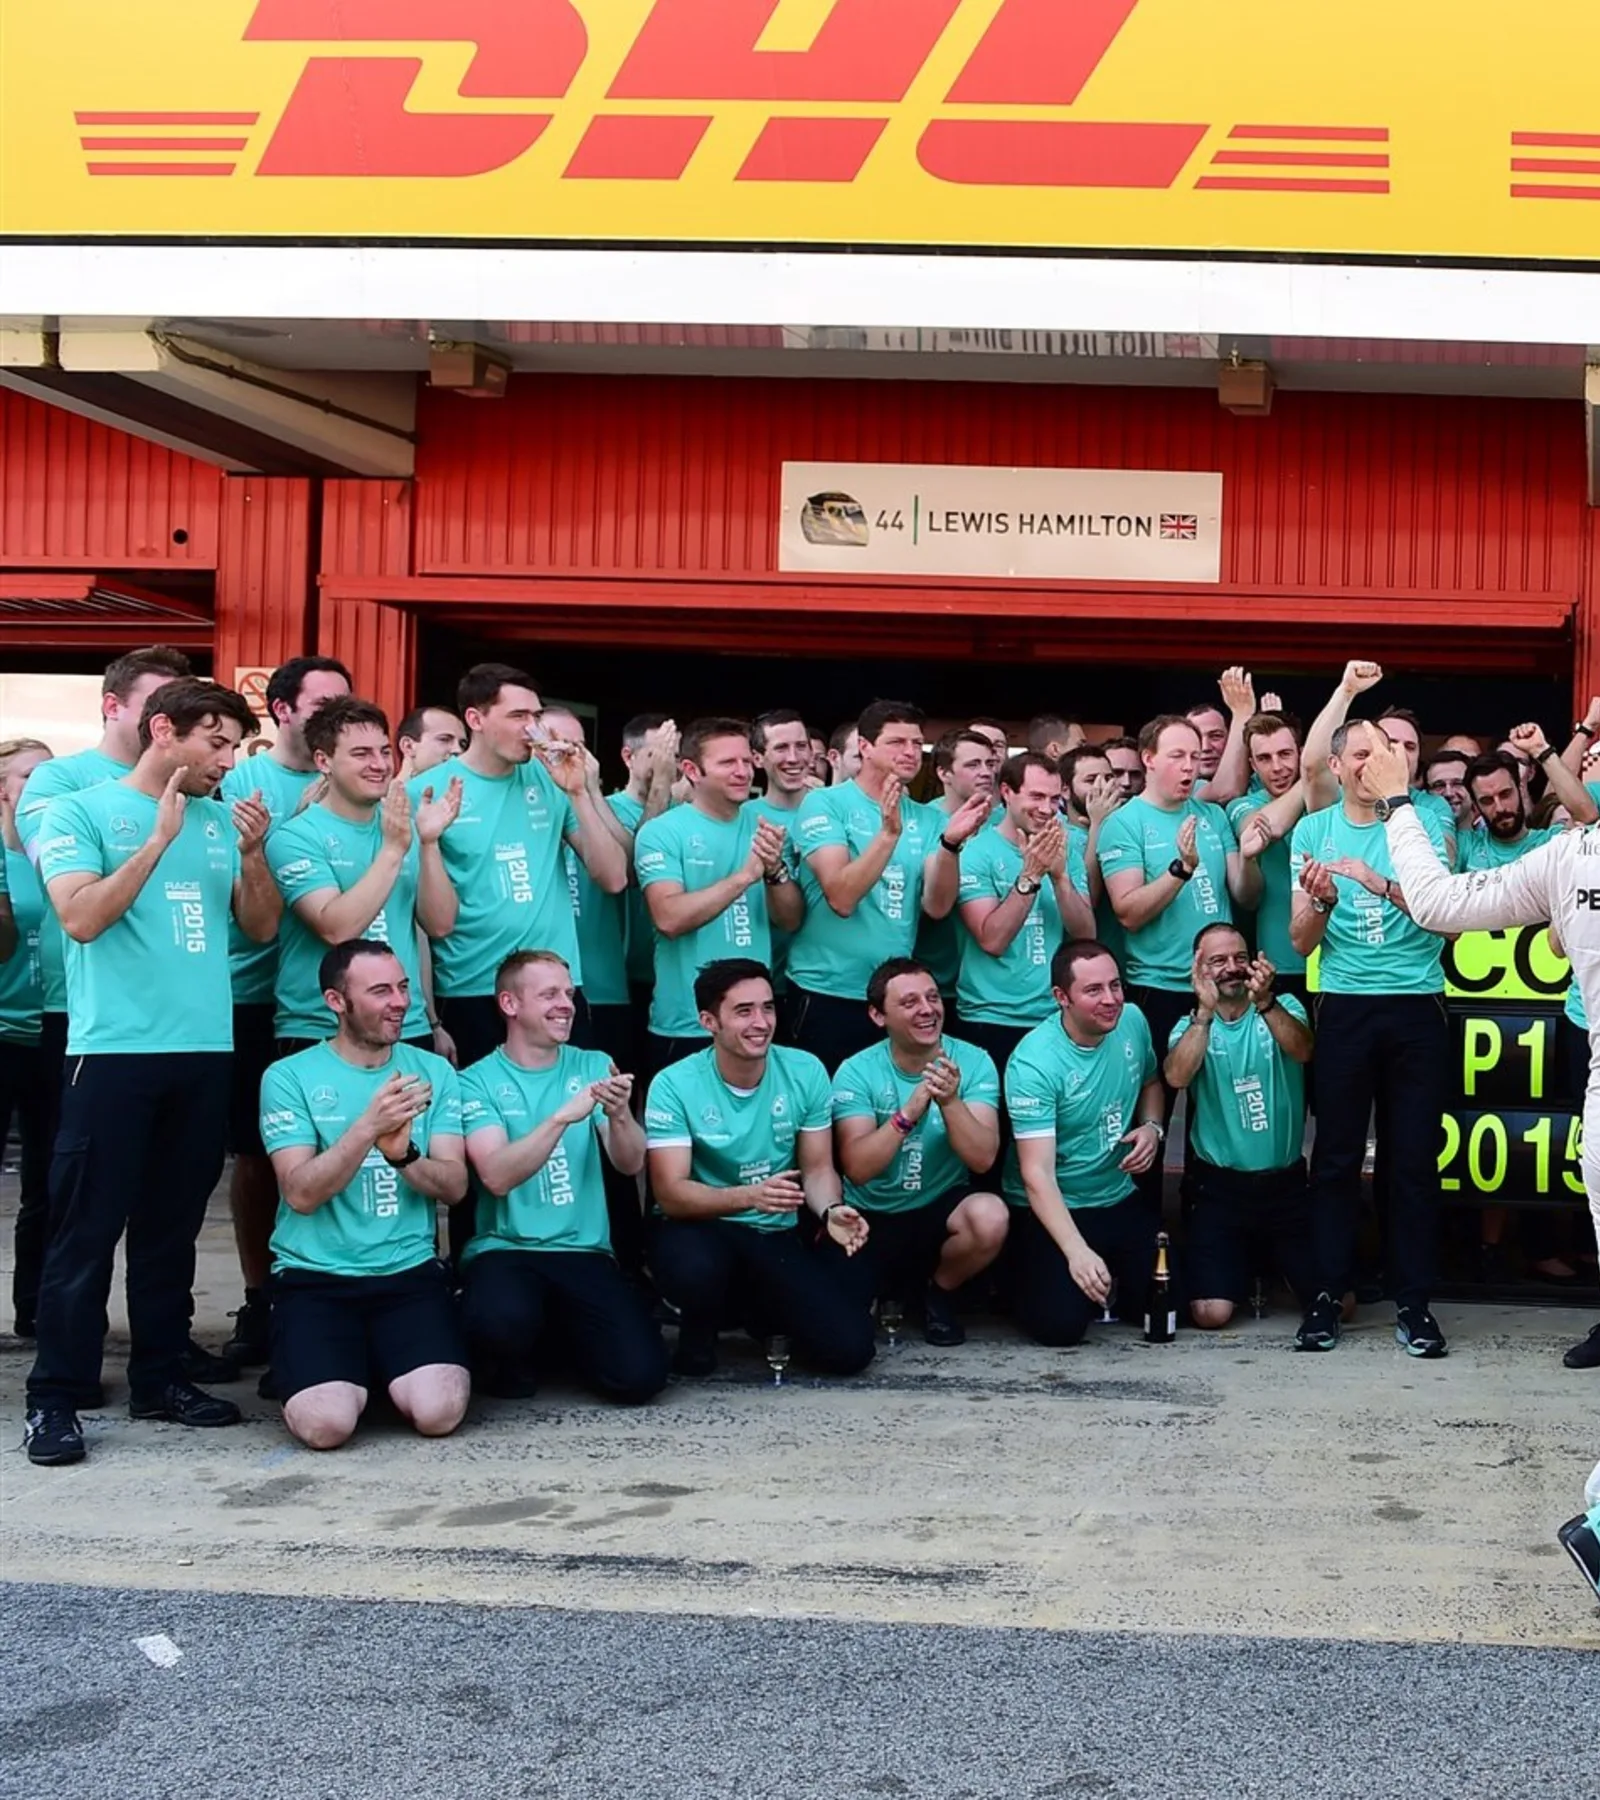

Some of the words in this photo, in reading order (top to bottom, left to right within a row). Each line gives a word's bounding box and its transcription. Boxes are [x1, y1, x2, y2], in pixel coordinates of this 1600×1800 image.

[242, 0, 1209, 188] DHL
[875, 509, 904, 532] 44
[928, 511, 1010, 535] LEWIS
[1018, 514, 1153, 538] HAMILTON
[509, 860, 534, 903] 2015
[888, 879, 904, 919] 2015
[1198, 878, 1219, 914] 2015
[183, 902, 206, 953] 2015
[733, 904, 753, 948] 2015
[1033, 926, 1047, 965] 2015
[1366, 908, 1385, 944] 2015
[1464, 1018, 1546, 1097] P1
[1246, 1090, 1268, 1132] 2015
[554, 1158, 575, 1207] 2015
[903, 1148, 923, 1191] 2015
[379, 1167, 400, 1218] 2015
